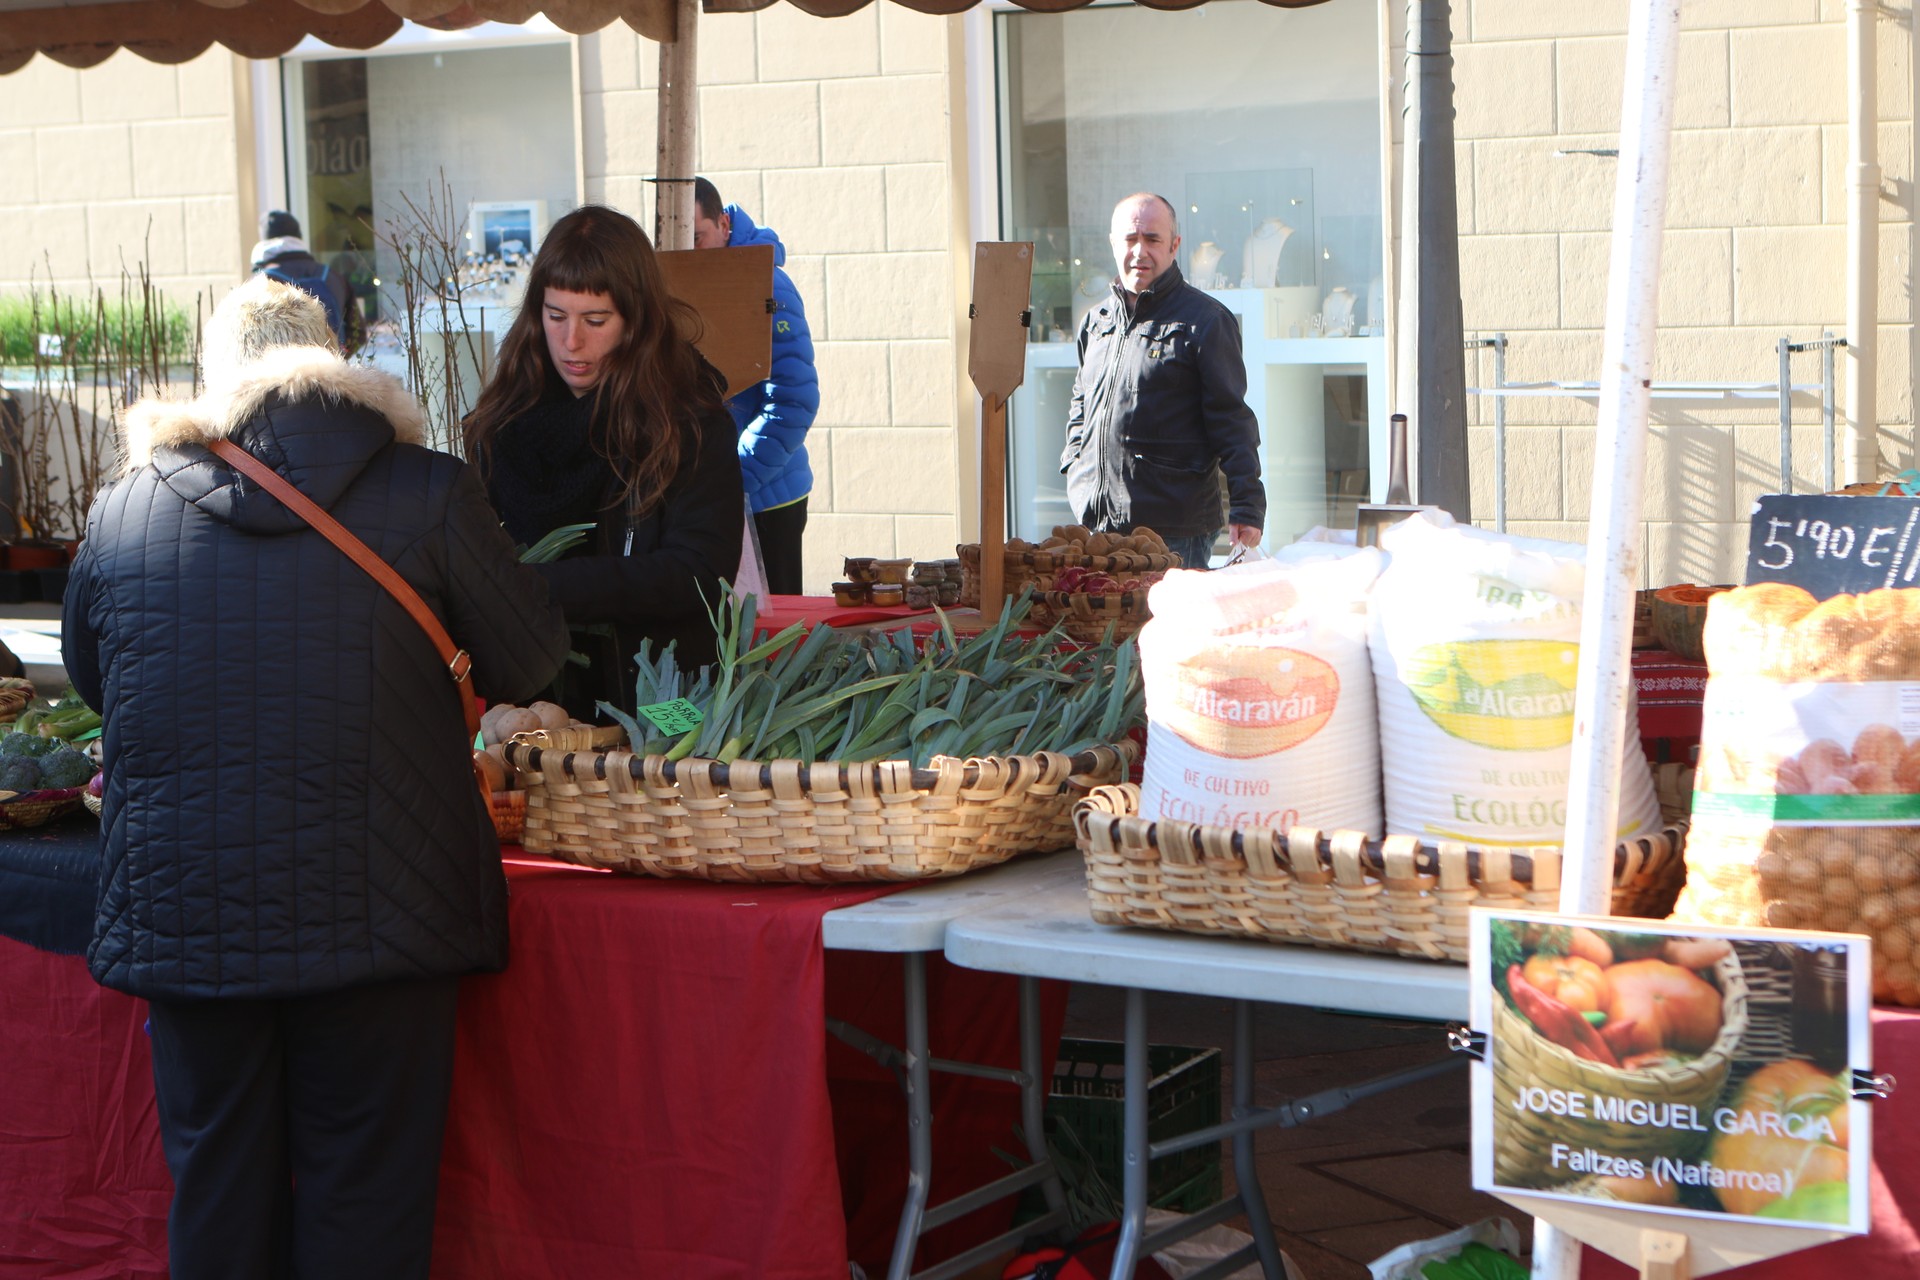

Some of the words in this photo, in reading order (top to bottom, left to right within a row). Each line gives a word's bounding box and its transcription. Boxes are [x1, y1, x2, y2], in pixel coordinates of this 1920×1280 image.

[1184, 768, 1200, 788] DE
[1205, 775, 1270, 797] CULTIVO
[1481, 769, 1501, 786] DE
[1512, 1085, 1587, 1119] JOSE
[1593, 1095, 1708, 1132] MIGUEL
[1551, 1143, 1645, 1180] Faltzes
[1652, 1156, 1795, 1198] (Nafarroa)
